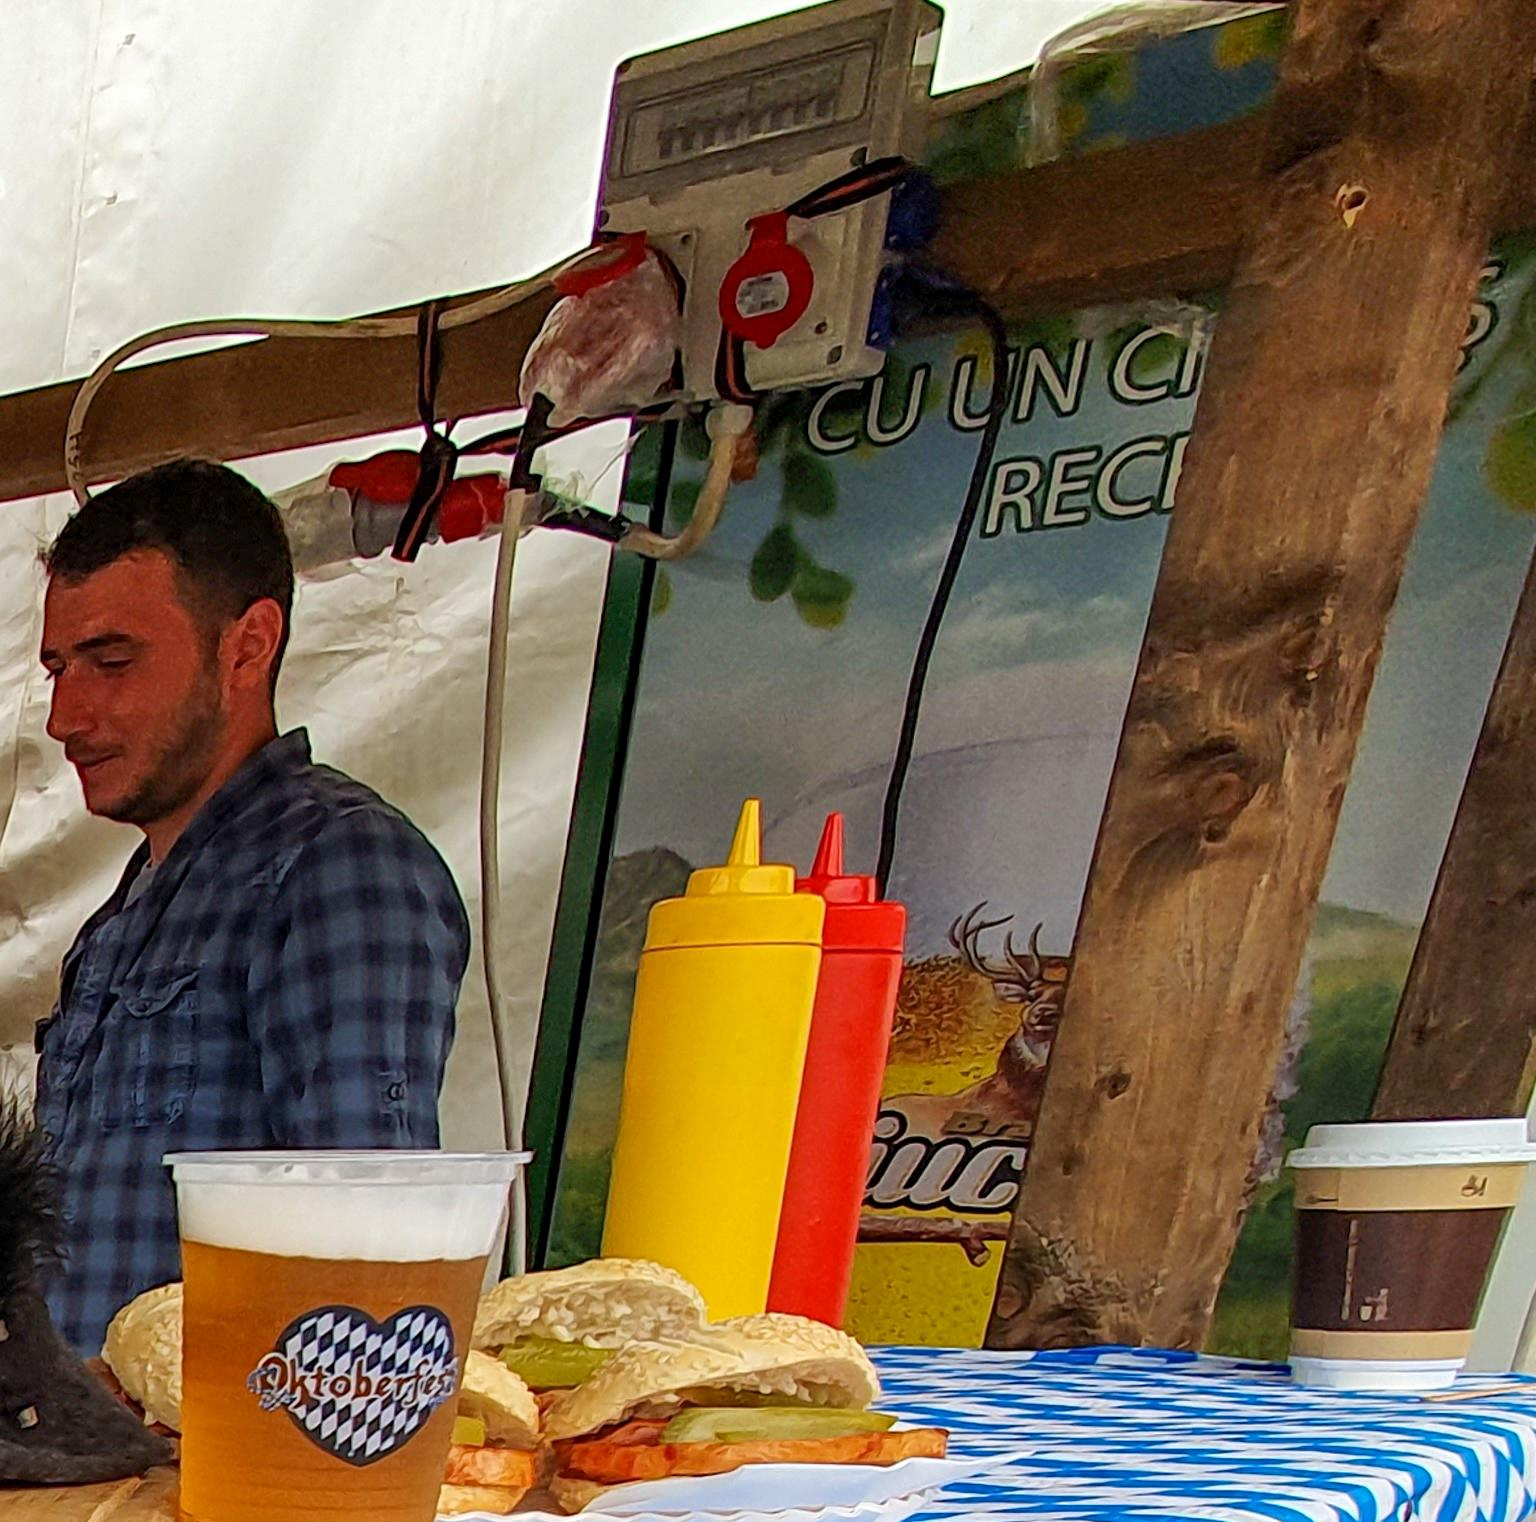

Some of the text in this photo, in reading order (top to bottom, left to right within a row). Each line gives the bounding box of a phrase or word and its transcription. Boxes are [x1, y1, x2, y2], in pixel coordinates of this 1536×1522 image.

[807, 319, 1206, 452] CU UN CI
[862, 1110, 1029, 1213] iuc
[941, 1110, 1032, 1140] Bra
